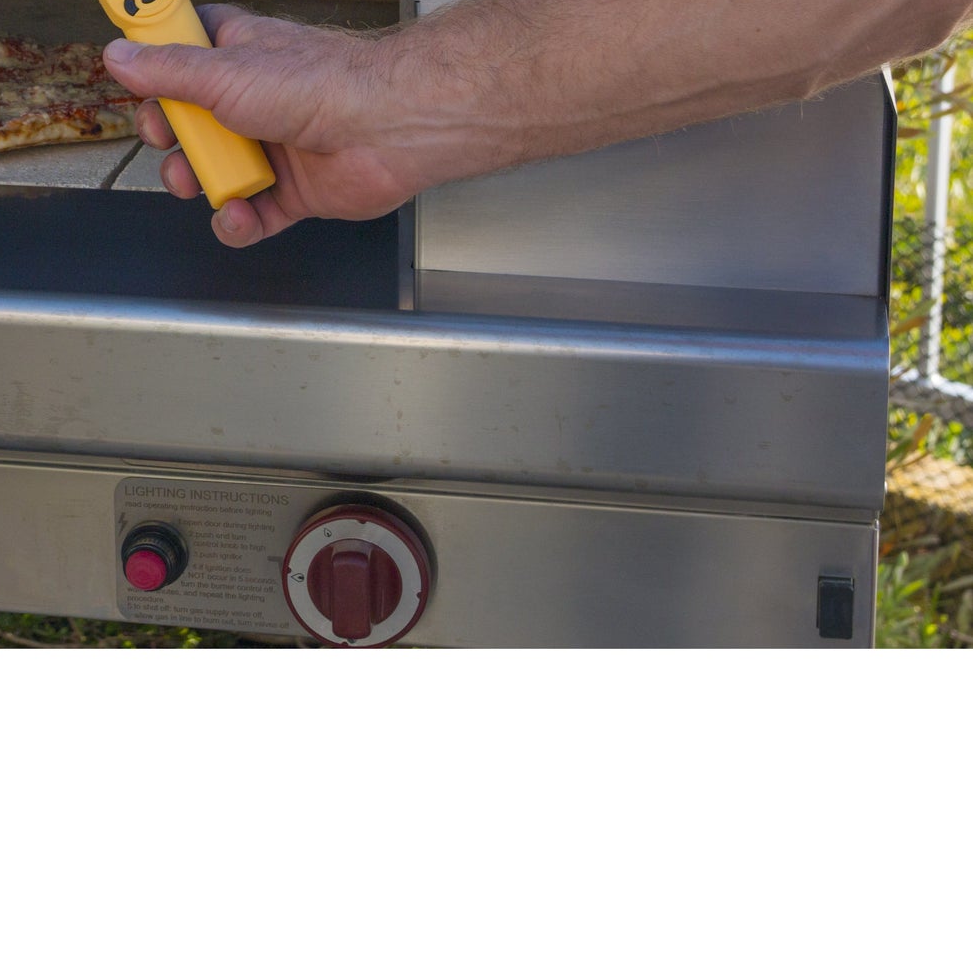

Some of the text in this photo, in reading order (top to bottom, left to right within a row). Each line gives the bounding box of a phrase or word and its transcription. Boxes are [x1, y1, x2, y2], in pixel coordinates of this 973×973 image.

[124, 485, 289, 505] LIGHTING INSTRUCTIONS
[143, 502, 177, 511] operating
[180, 503, 217, 512] instruction
[245, 507, 272, 516] lighting
[203, 519, 220, 527] door
[223, 521, 246, 530] during
[247, 522, 275, 531] lighting
[237, 593, 265, 602] lighting
[204, 608, 229, 616] supply
